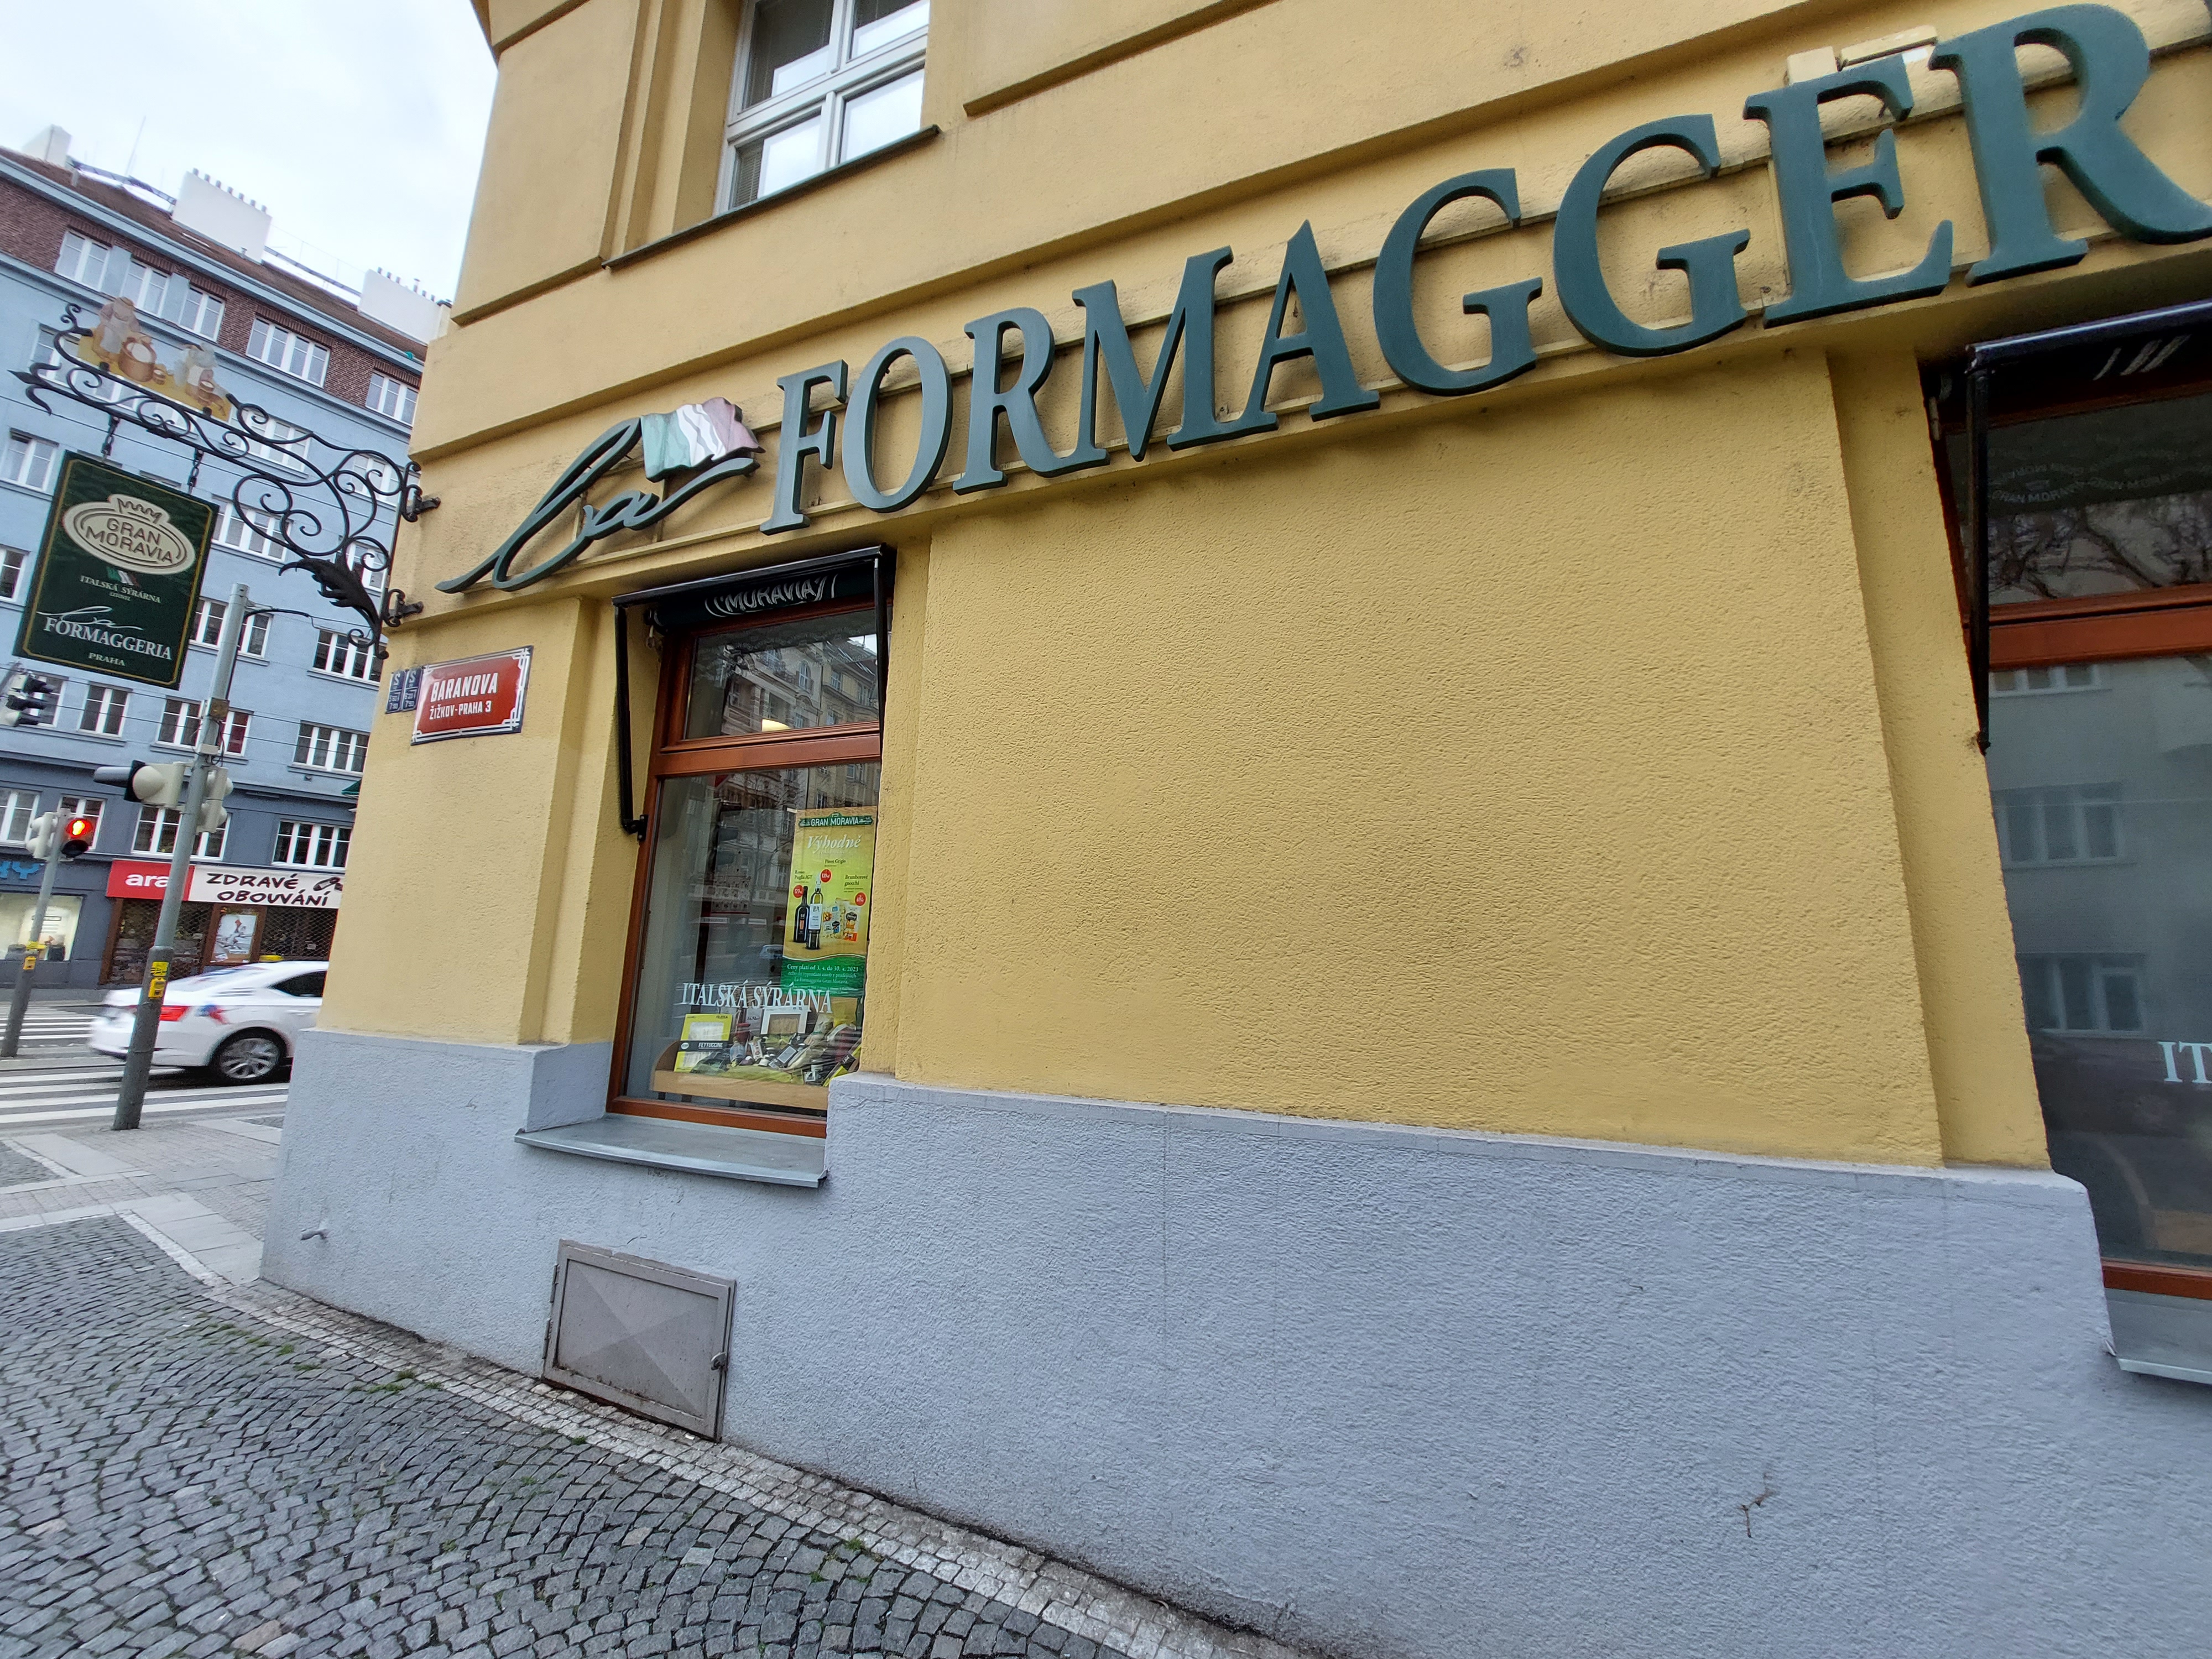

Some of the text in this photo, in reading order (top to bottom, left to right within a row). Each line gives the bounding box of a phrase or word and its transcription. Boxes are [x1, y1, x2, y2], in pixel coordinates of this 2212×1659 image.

[760, 2, 2212, 535] FORMAGGER
[85, 525, 174, 564] MORAVIA
[107, 518, 161, 546] GRAN
[80, 575, 161, 603] ITALSKÁ SÝRÁRNA
[43, 617, 173, 660] FORMAGGERIA
[88, 652, 126, 666] PRAHA
[430, 672, 498, 702] BARANOVA
[485, 700, 492, 713] 3
[811, 817, 859, 827] GRAN MORAVIA
[807, 833, 863, 854] Výhodně
[206, 873, 299, 889] ZDRAVÉ
[681, 979, 833, 1014] ITALSKÁ SÝRÁRNA
